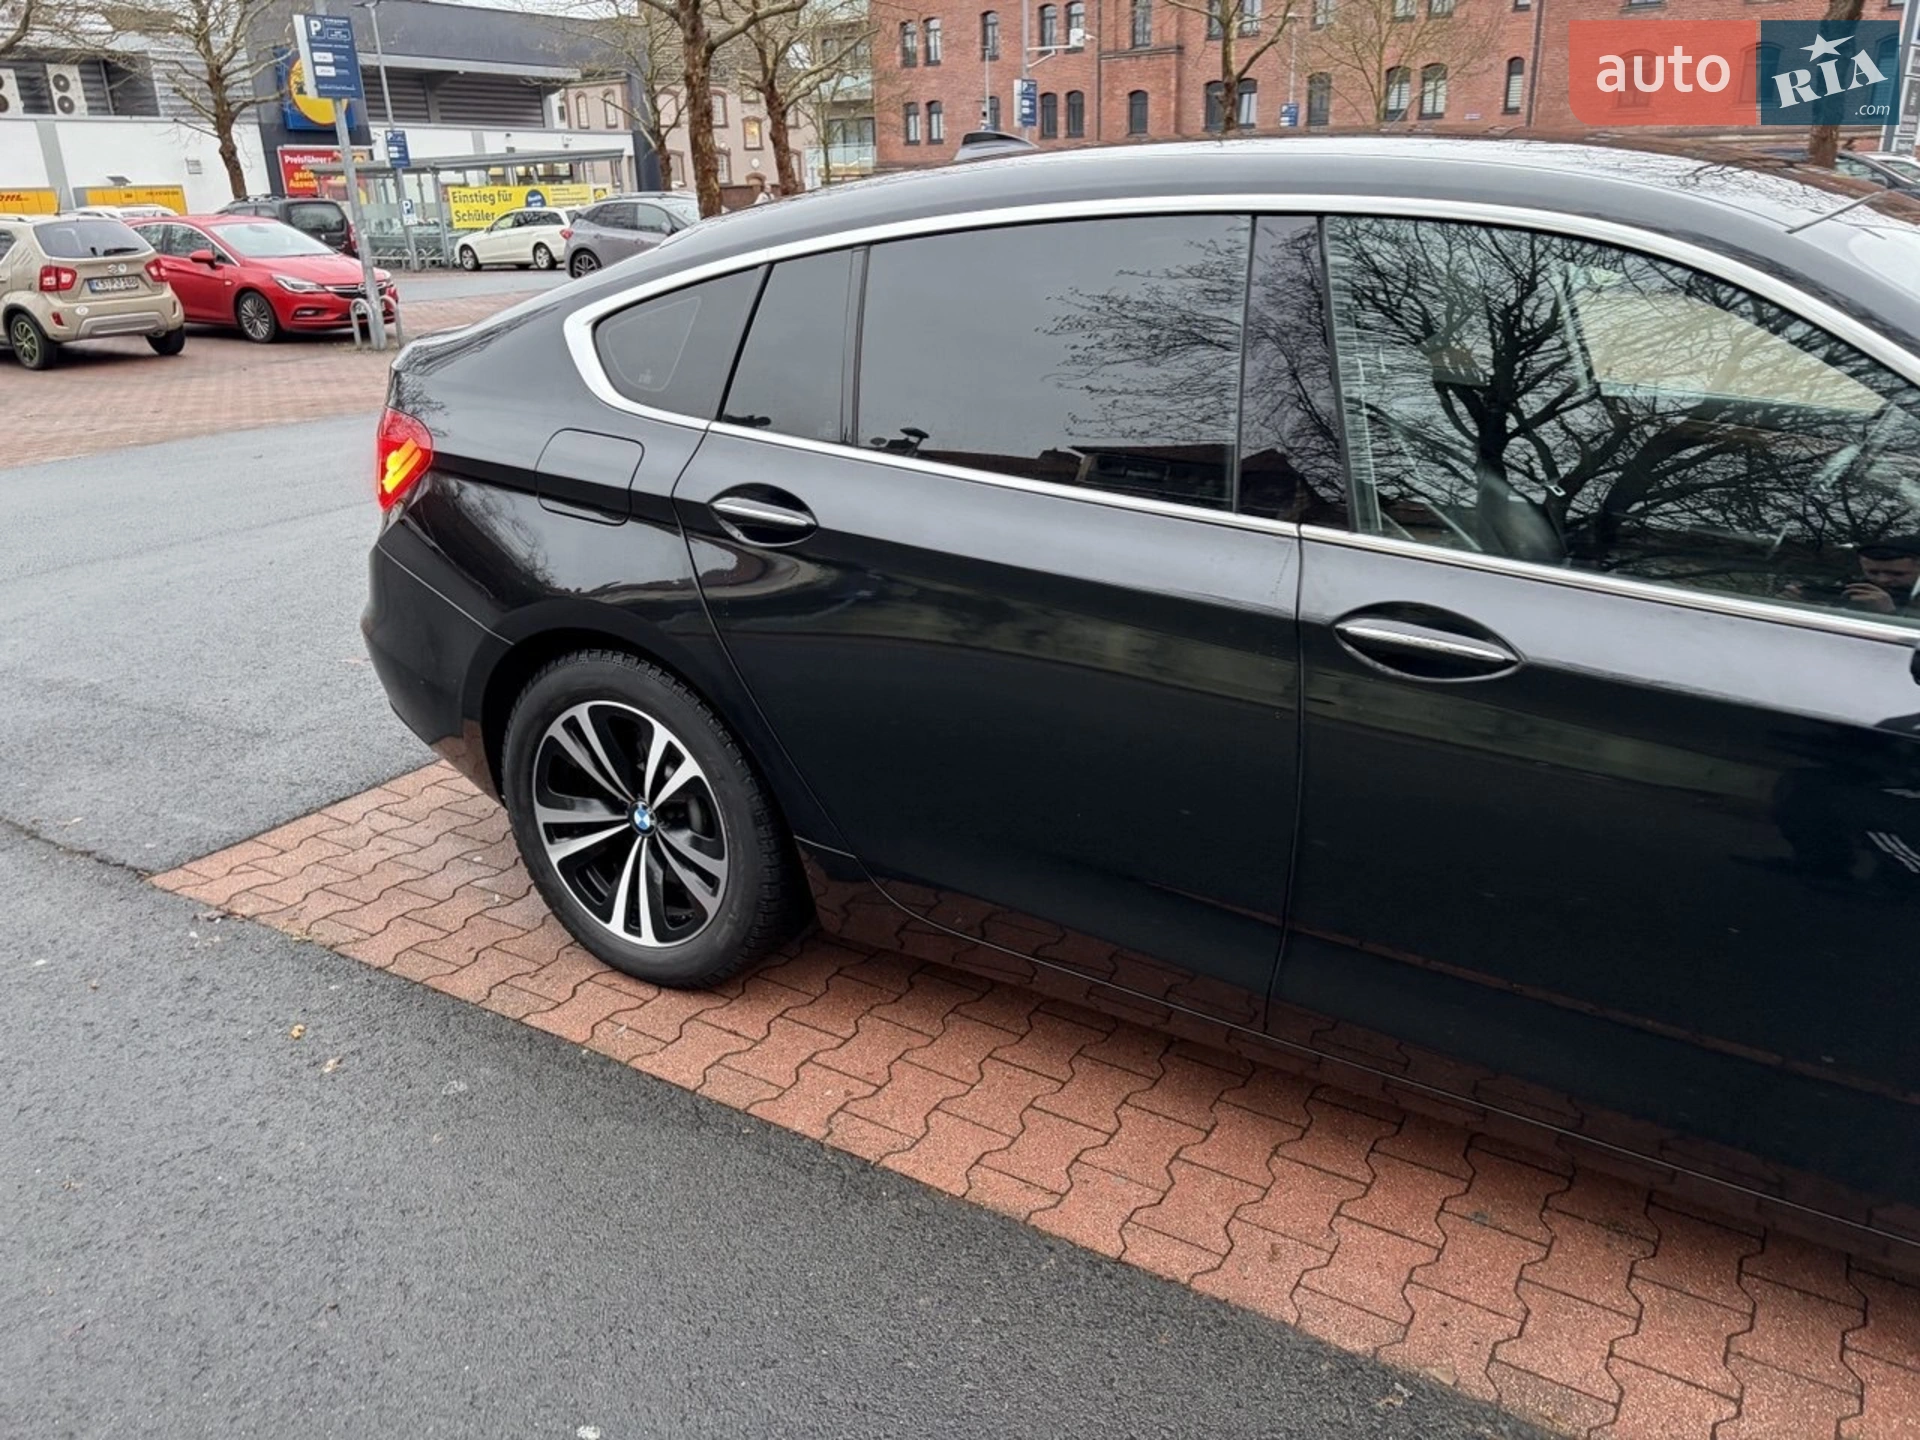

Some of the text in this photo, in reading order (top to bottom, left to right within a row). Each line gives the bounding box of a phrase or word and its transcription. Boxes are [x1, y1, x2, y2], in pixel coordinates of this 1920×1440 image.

[310, 19, 322, 36] P
[451, 190, 496, 206] Einstieg
[497, 189, 513, 202] für
[402, 200, 412, 214] P
[454, 209, 496, 222] Schüler
